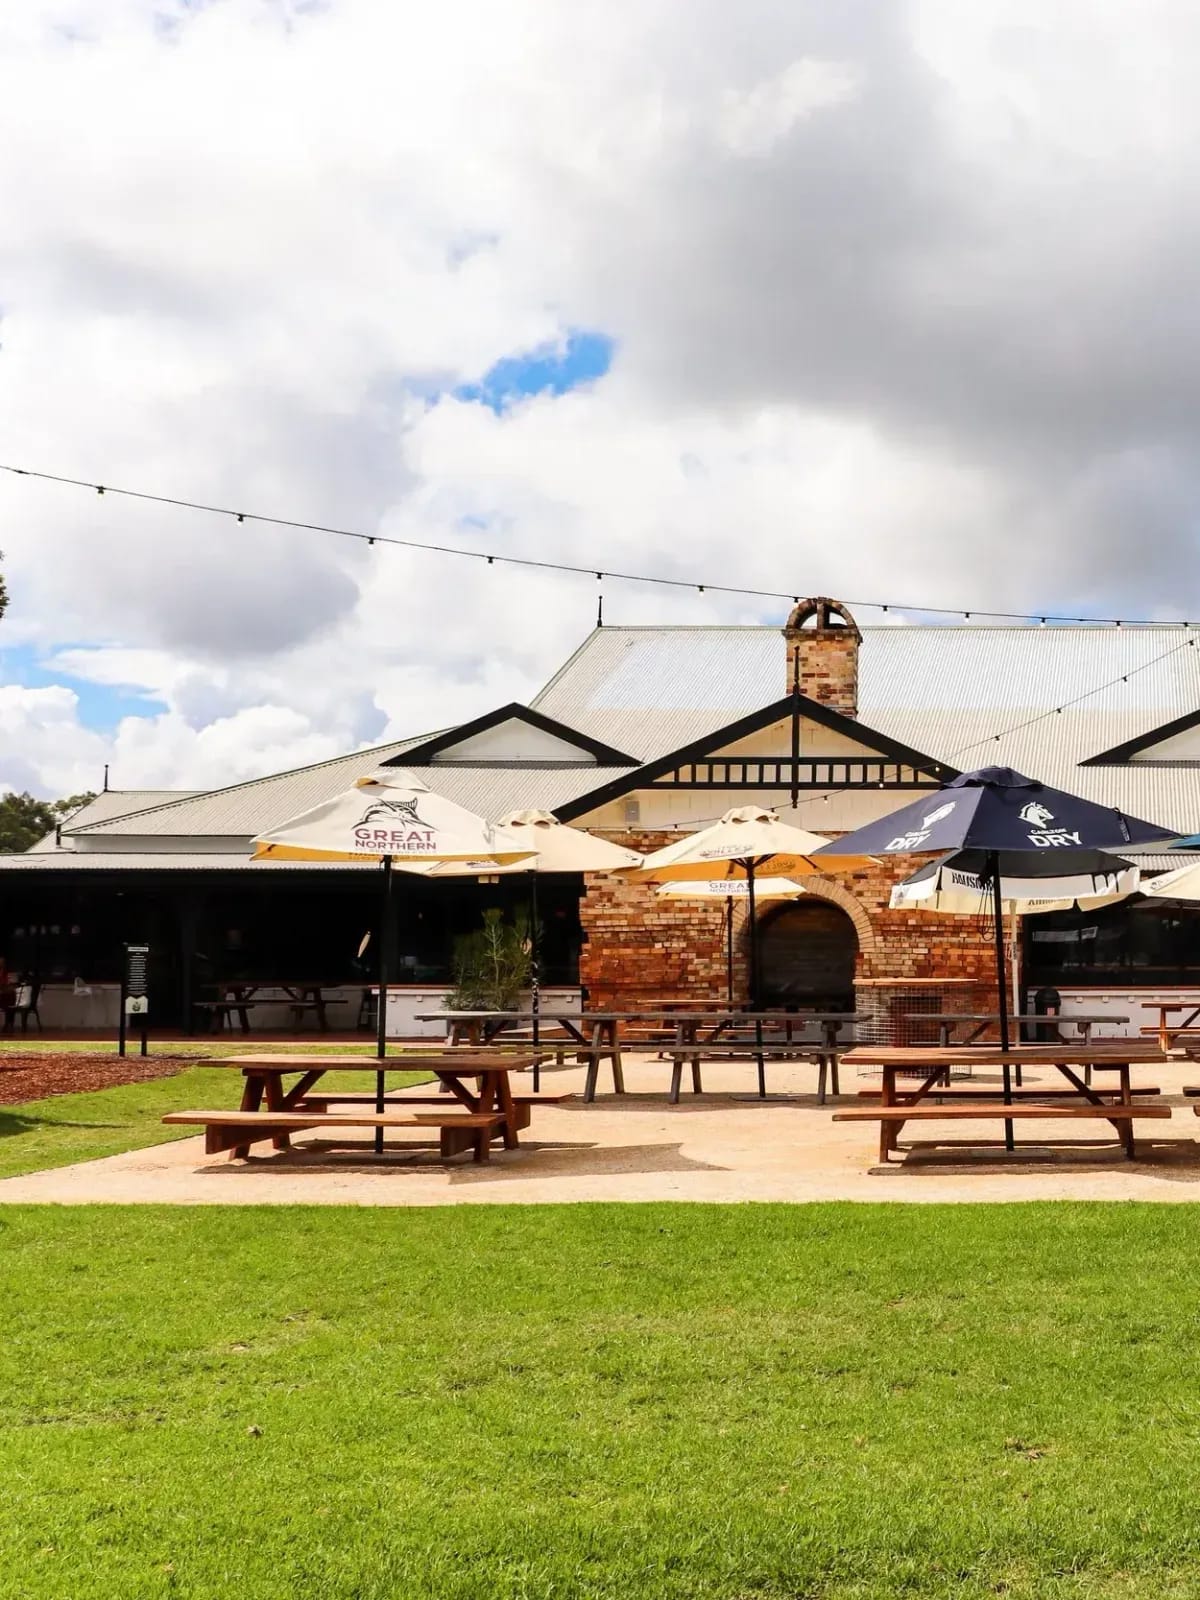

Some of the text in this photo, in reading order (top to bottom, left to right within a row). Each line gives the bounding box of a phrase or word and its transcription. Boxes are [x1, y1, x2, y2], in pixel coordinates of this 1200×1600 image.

[354, 828, 435, 842] GREAT
[884, 833, 932, 851] DRY
[1026, 831, 1083, 847] DRY
[354, 840, 437, 850] NORTHERN
